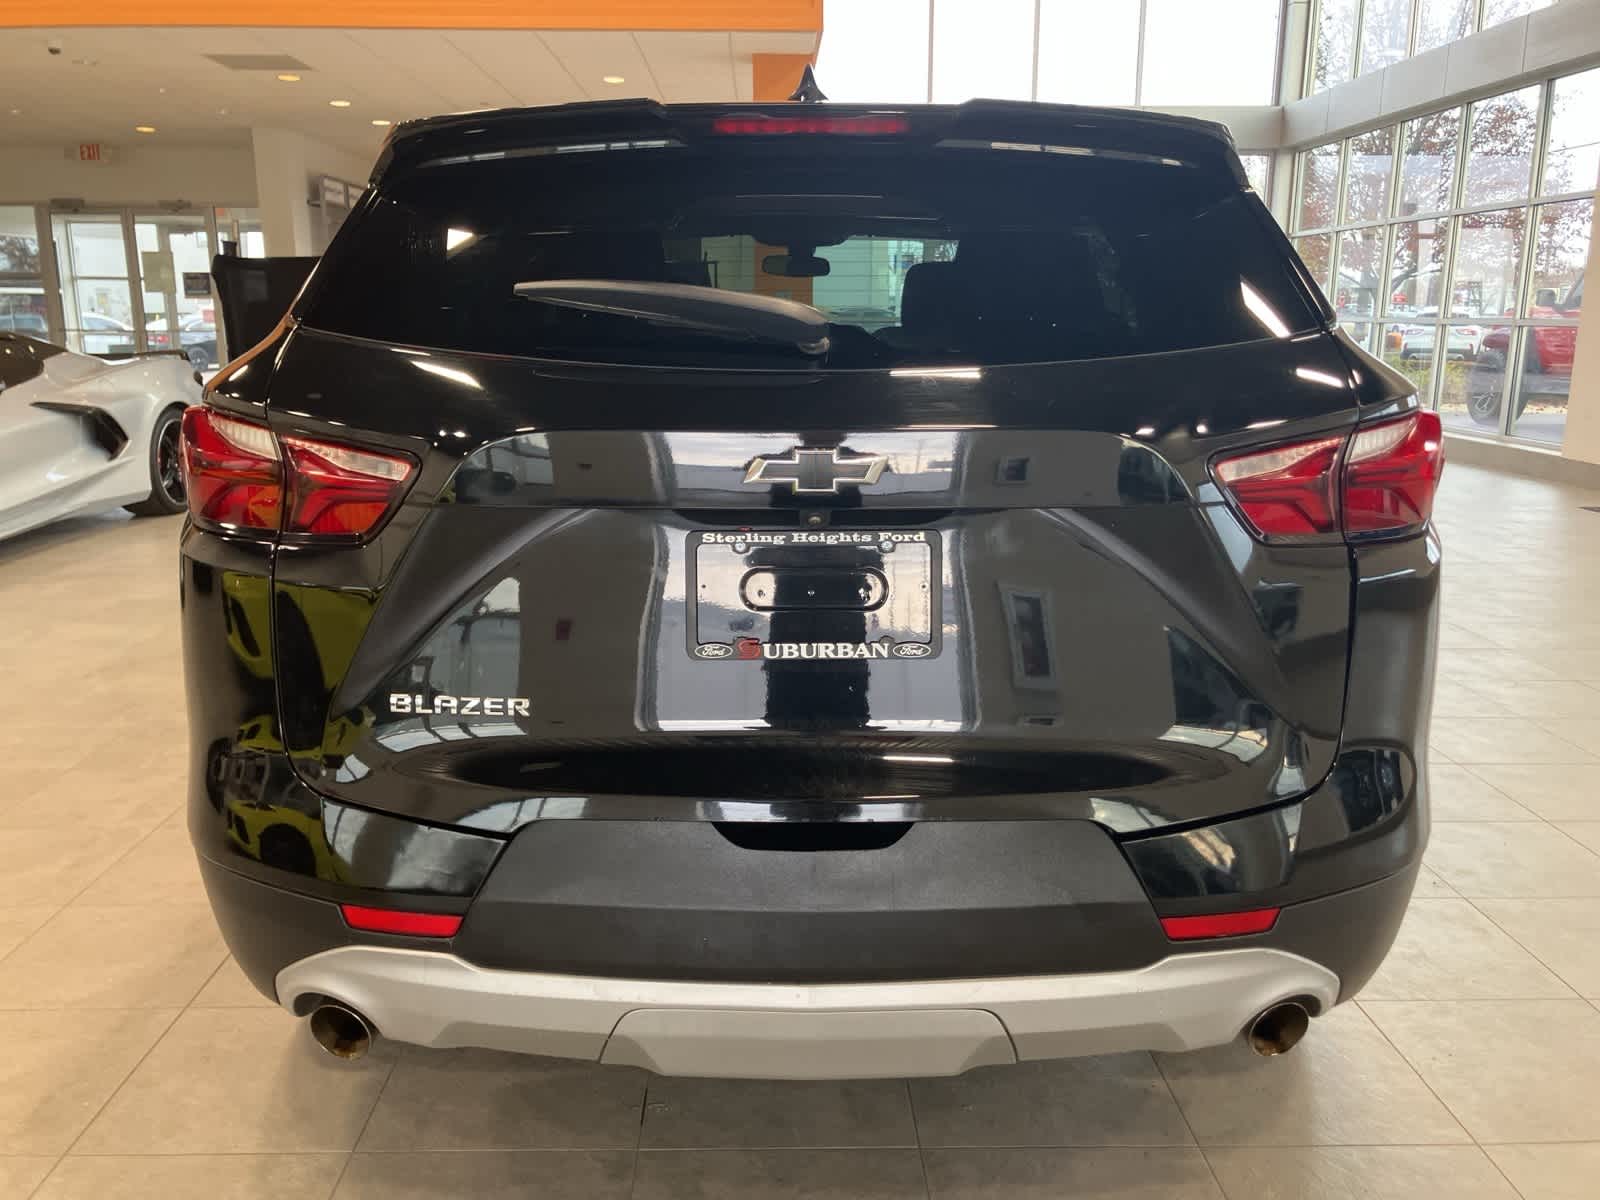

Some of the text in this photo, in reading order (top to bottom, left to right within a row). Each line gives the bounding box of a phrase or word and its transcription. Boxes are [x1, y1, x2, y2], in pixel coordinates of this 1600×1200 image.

[80, 144, 100, 160] EXIT
[702, 532, 926, 545] Sterling Heights Ford
[737, 638, 889, 660] SUBURBAN
[389, 693, 531, 717] BLAZER
